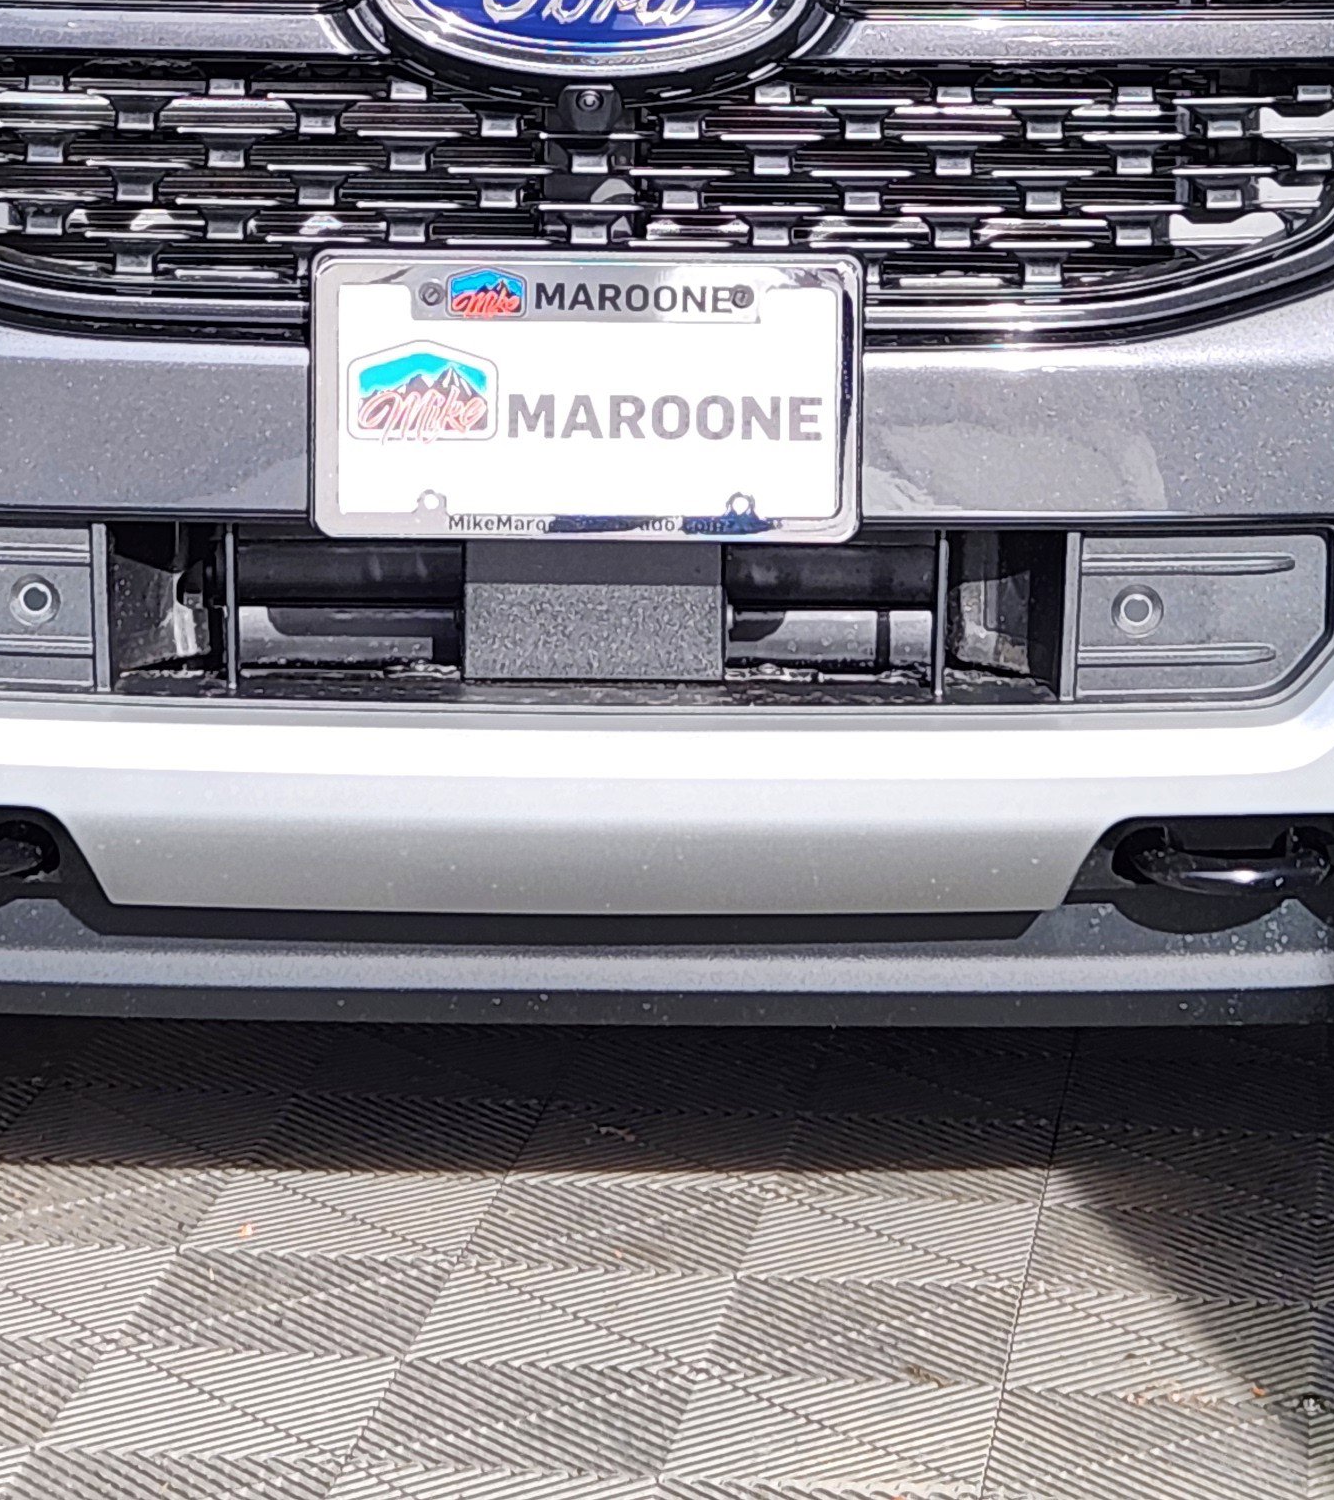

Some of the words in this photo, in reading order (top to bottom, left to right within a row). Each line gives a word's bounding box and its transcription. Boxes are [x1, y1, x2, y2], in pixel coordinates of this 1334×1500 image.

[452, 290, 521, 319] Mike
[535, 282, 734, 314] MAROONE
[358, 385, 488, 445] Mike
[508, 394, 822, 441] MAROONE
